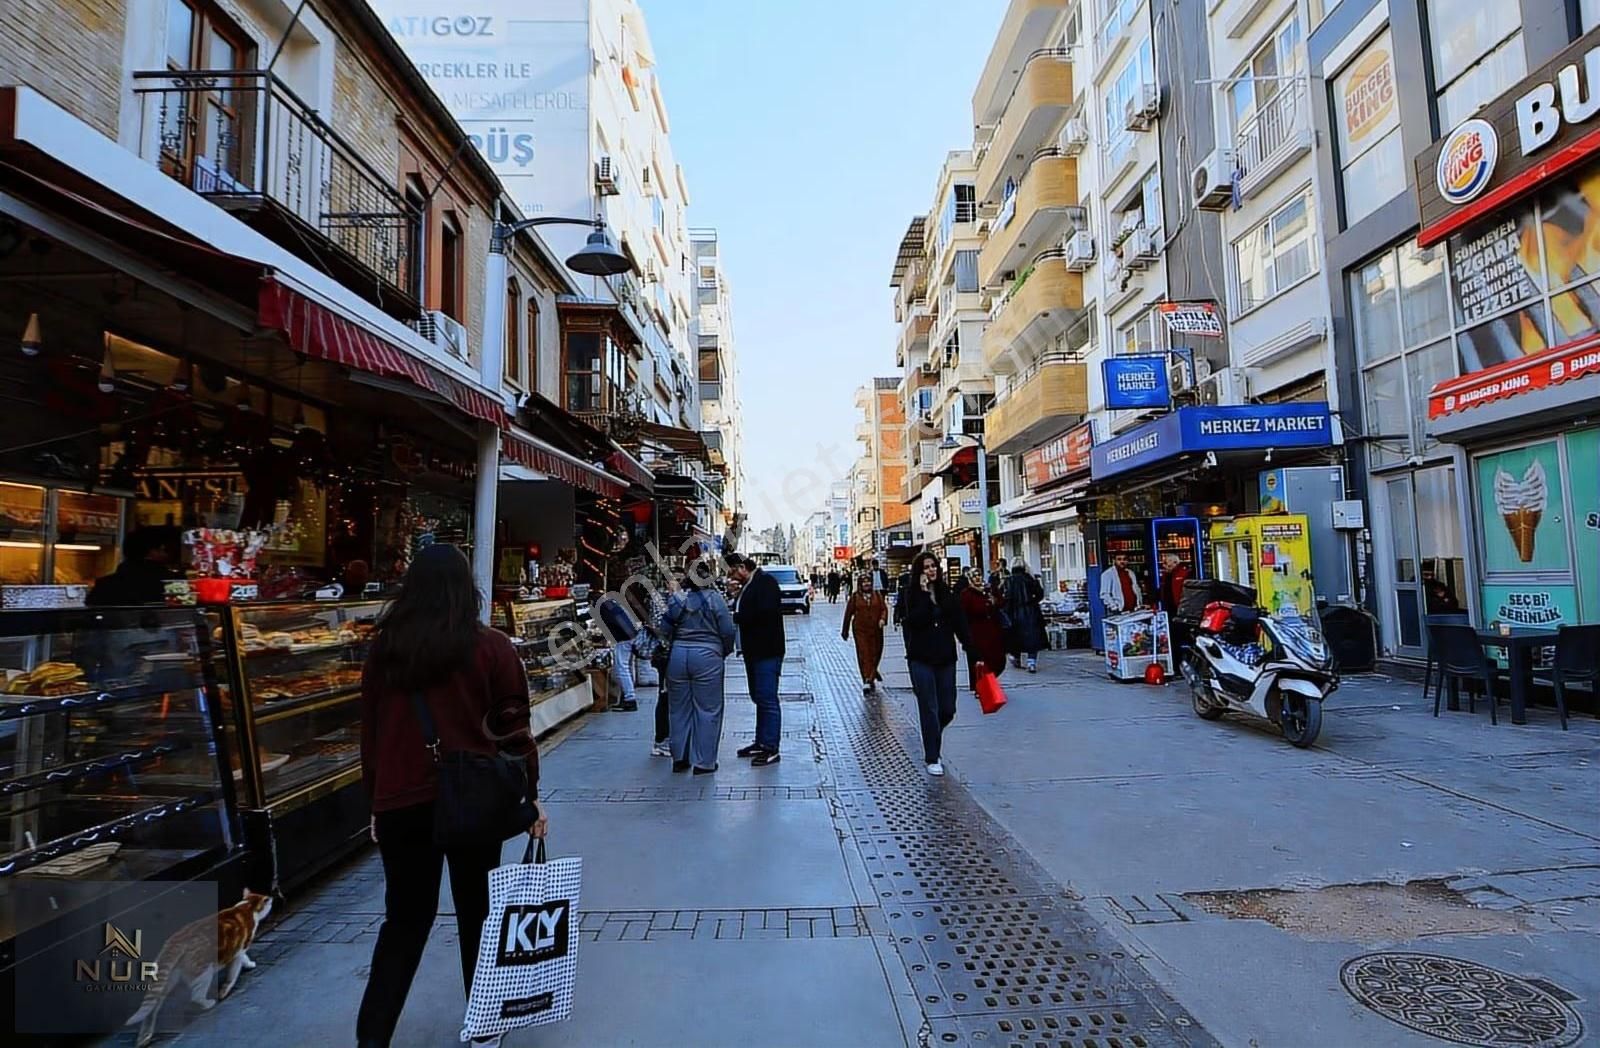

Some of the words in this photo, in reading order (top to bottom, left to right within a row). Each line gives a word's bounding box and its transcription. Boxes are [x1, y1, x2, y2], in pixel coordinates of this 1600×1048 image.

[1346, 62, 1391, 113] BURGER
[1347, 78, 1394, 133] KING
[1463, 278, 1532, 324] LEZZETE
[1571, 353, 1600, 371] BUR
[1117, 372, 1155, 381] MERKEZ
[1118, 381, 1156, 391] MARKET
[1459, 384, 1500, 404] BURGER
[1501, 374, 1530, 392] KING
[1200, 419, 1261, 435] MERKEZ
[1264, 416, 1325, 432] MARKET
[1106, 444, 1130, 465] MERKEZ
[1130, 432, 1159, 455] MARKET
[1588, 513, 1600, 528] S
[1509, 594, 1531, 609] SEÇ
